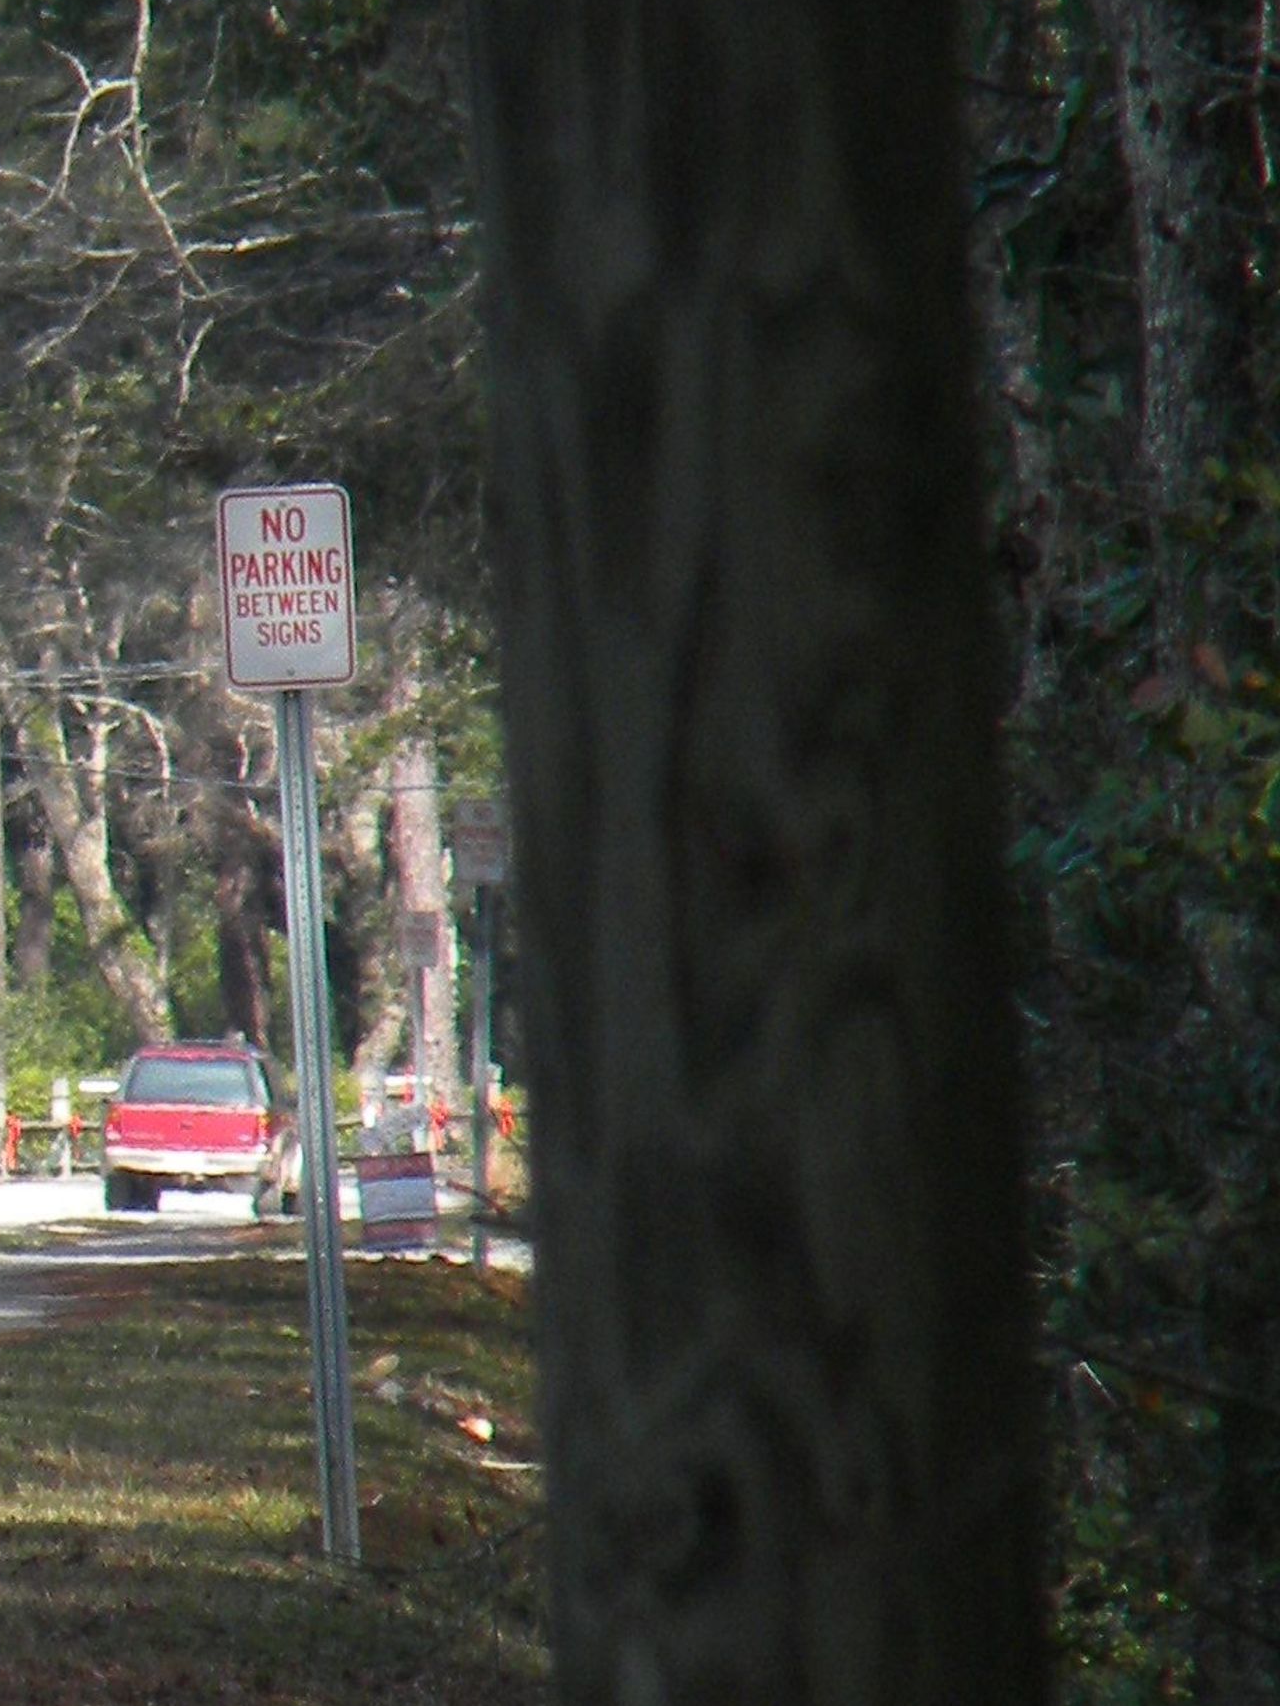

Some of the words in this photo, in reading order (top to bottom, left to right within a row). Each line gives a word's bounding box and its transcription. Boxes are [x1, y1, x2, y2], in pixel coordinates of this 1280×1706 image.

[261, 507, 306, 542] NO
[231, 548, 342, 588] PARKING
[236, 590, 338, 618] BETWEEN
[257, 620, 322, 647] SIGNS
